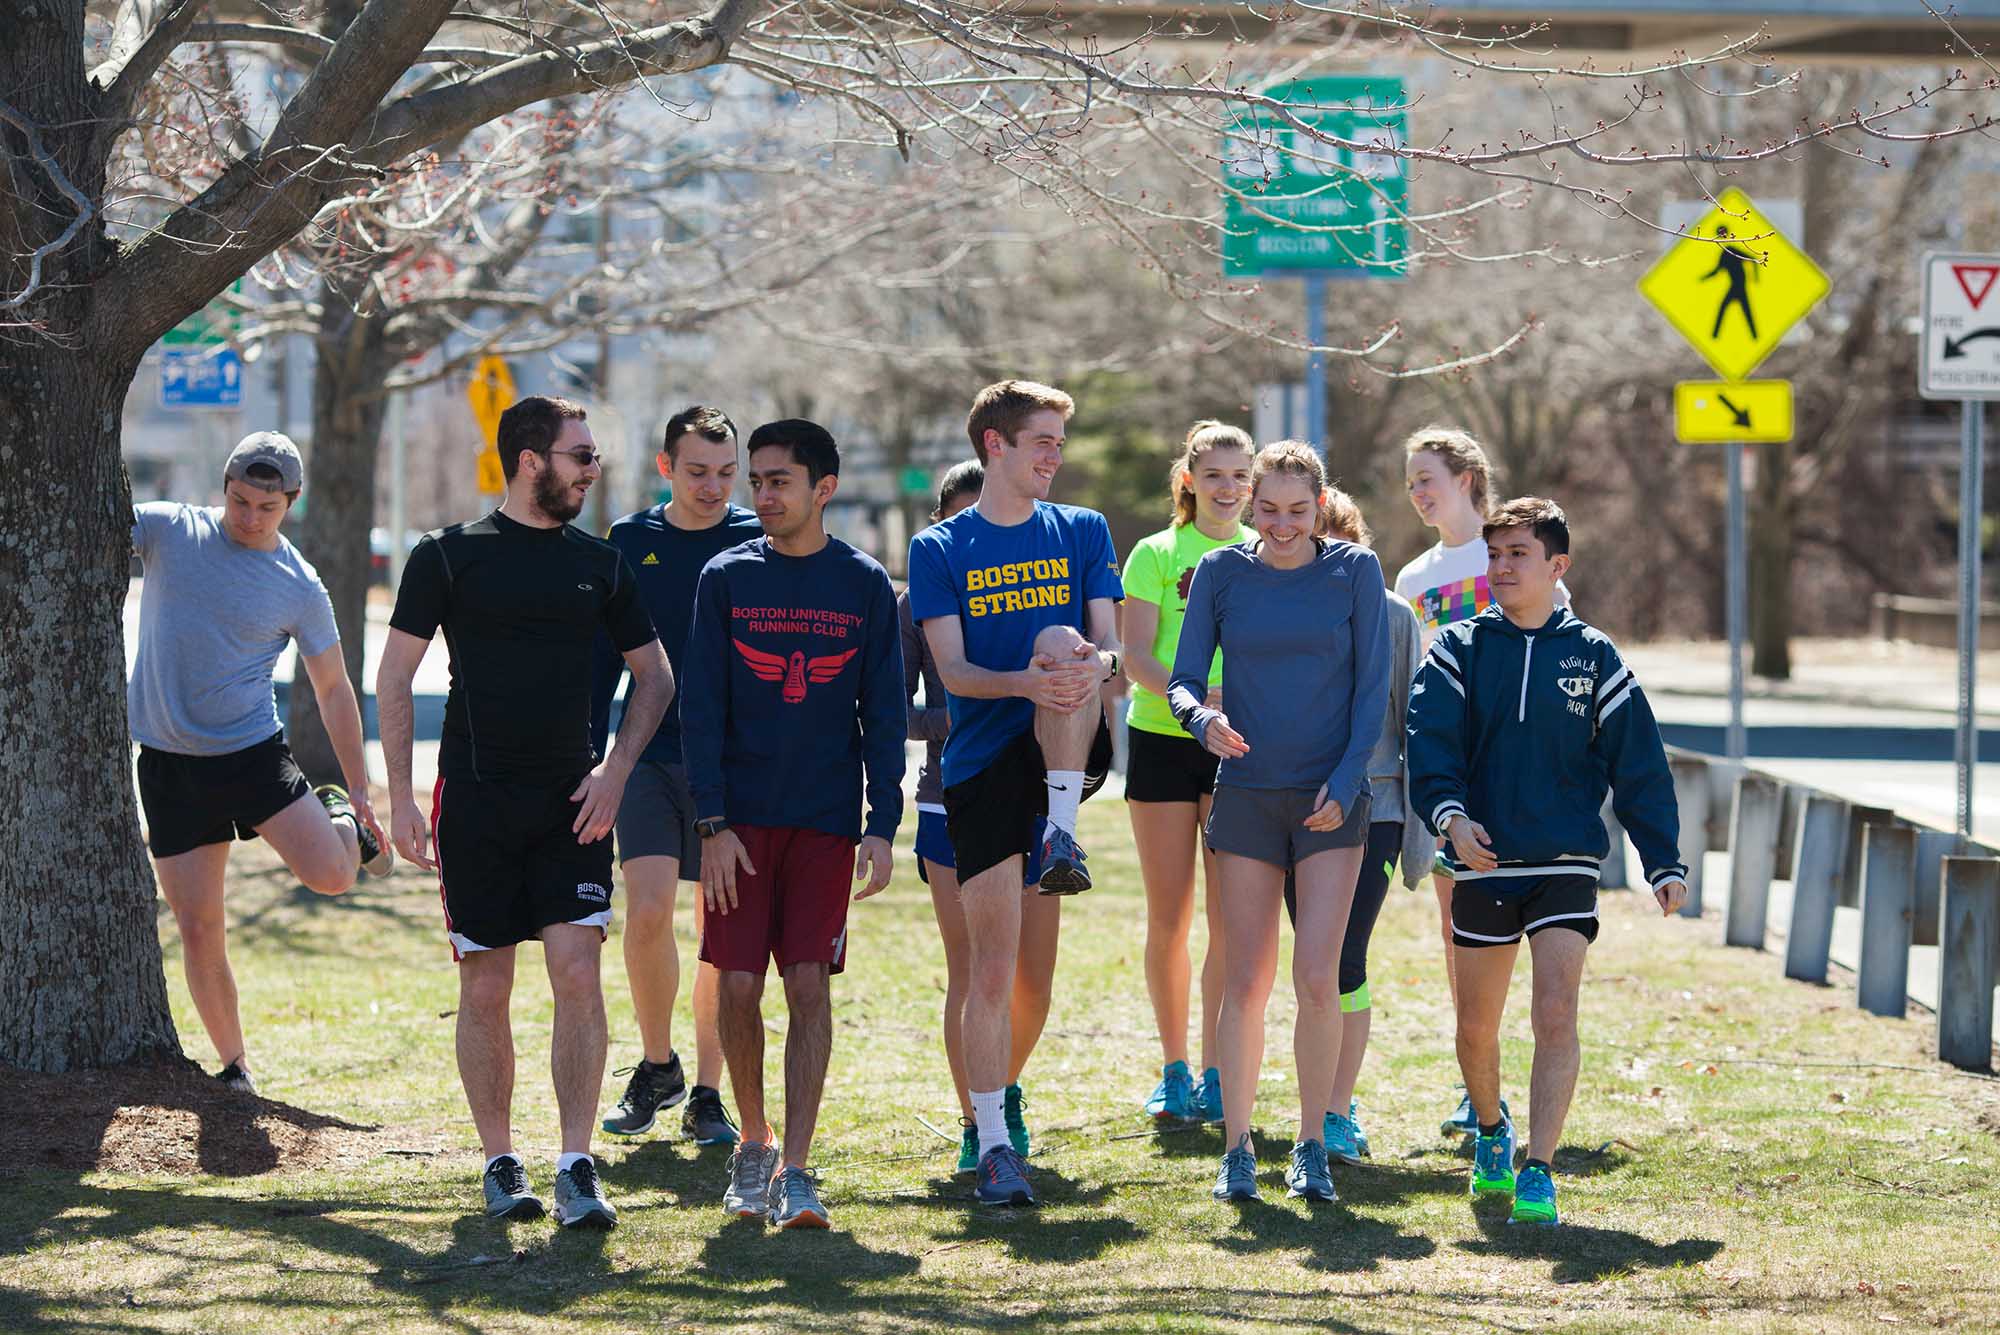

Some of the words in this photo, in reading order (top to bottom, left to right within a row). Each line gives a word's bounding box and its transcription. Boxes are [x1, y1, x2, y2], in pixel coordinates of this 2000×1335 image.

[967, 558, 1070, 591] BOSTON
[969, 585, 1071, 617] STRONG
[731, 608, 787, 619] BOSTON
[790, 608, 864, 628] UNIVERSITY
[749, 621, 809, 633] RUNNING
[813, 622, 848, 638] CLUB
[1566, 699, 1588, 717] PARK
[576, 883, 607, 898] BOSTON
